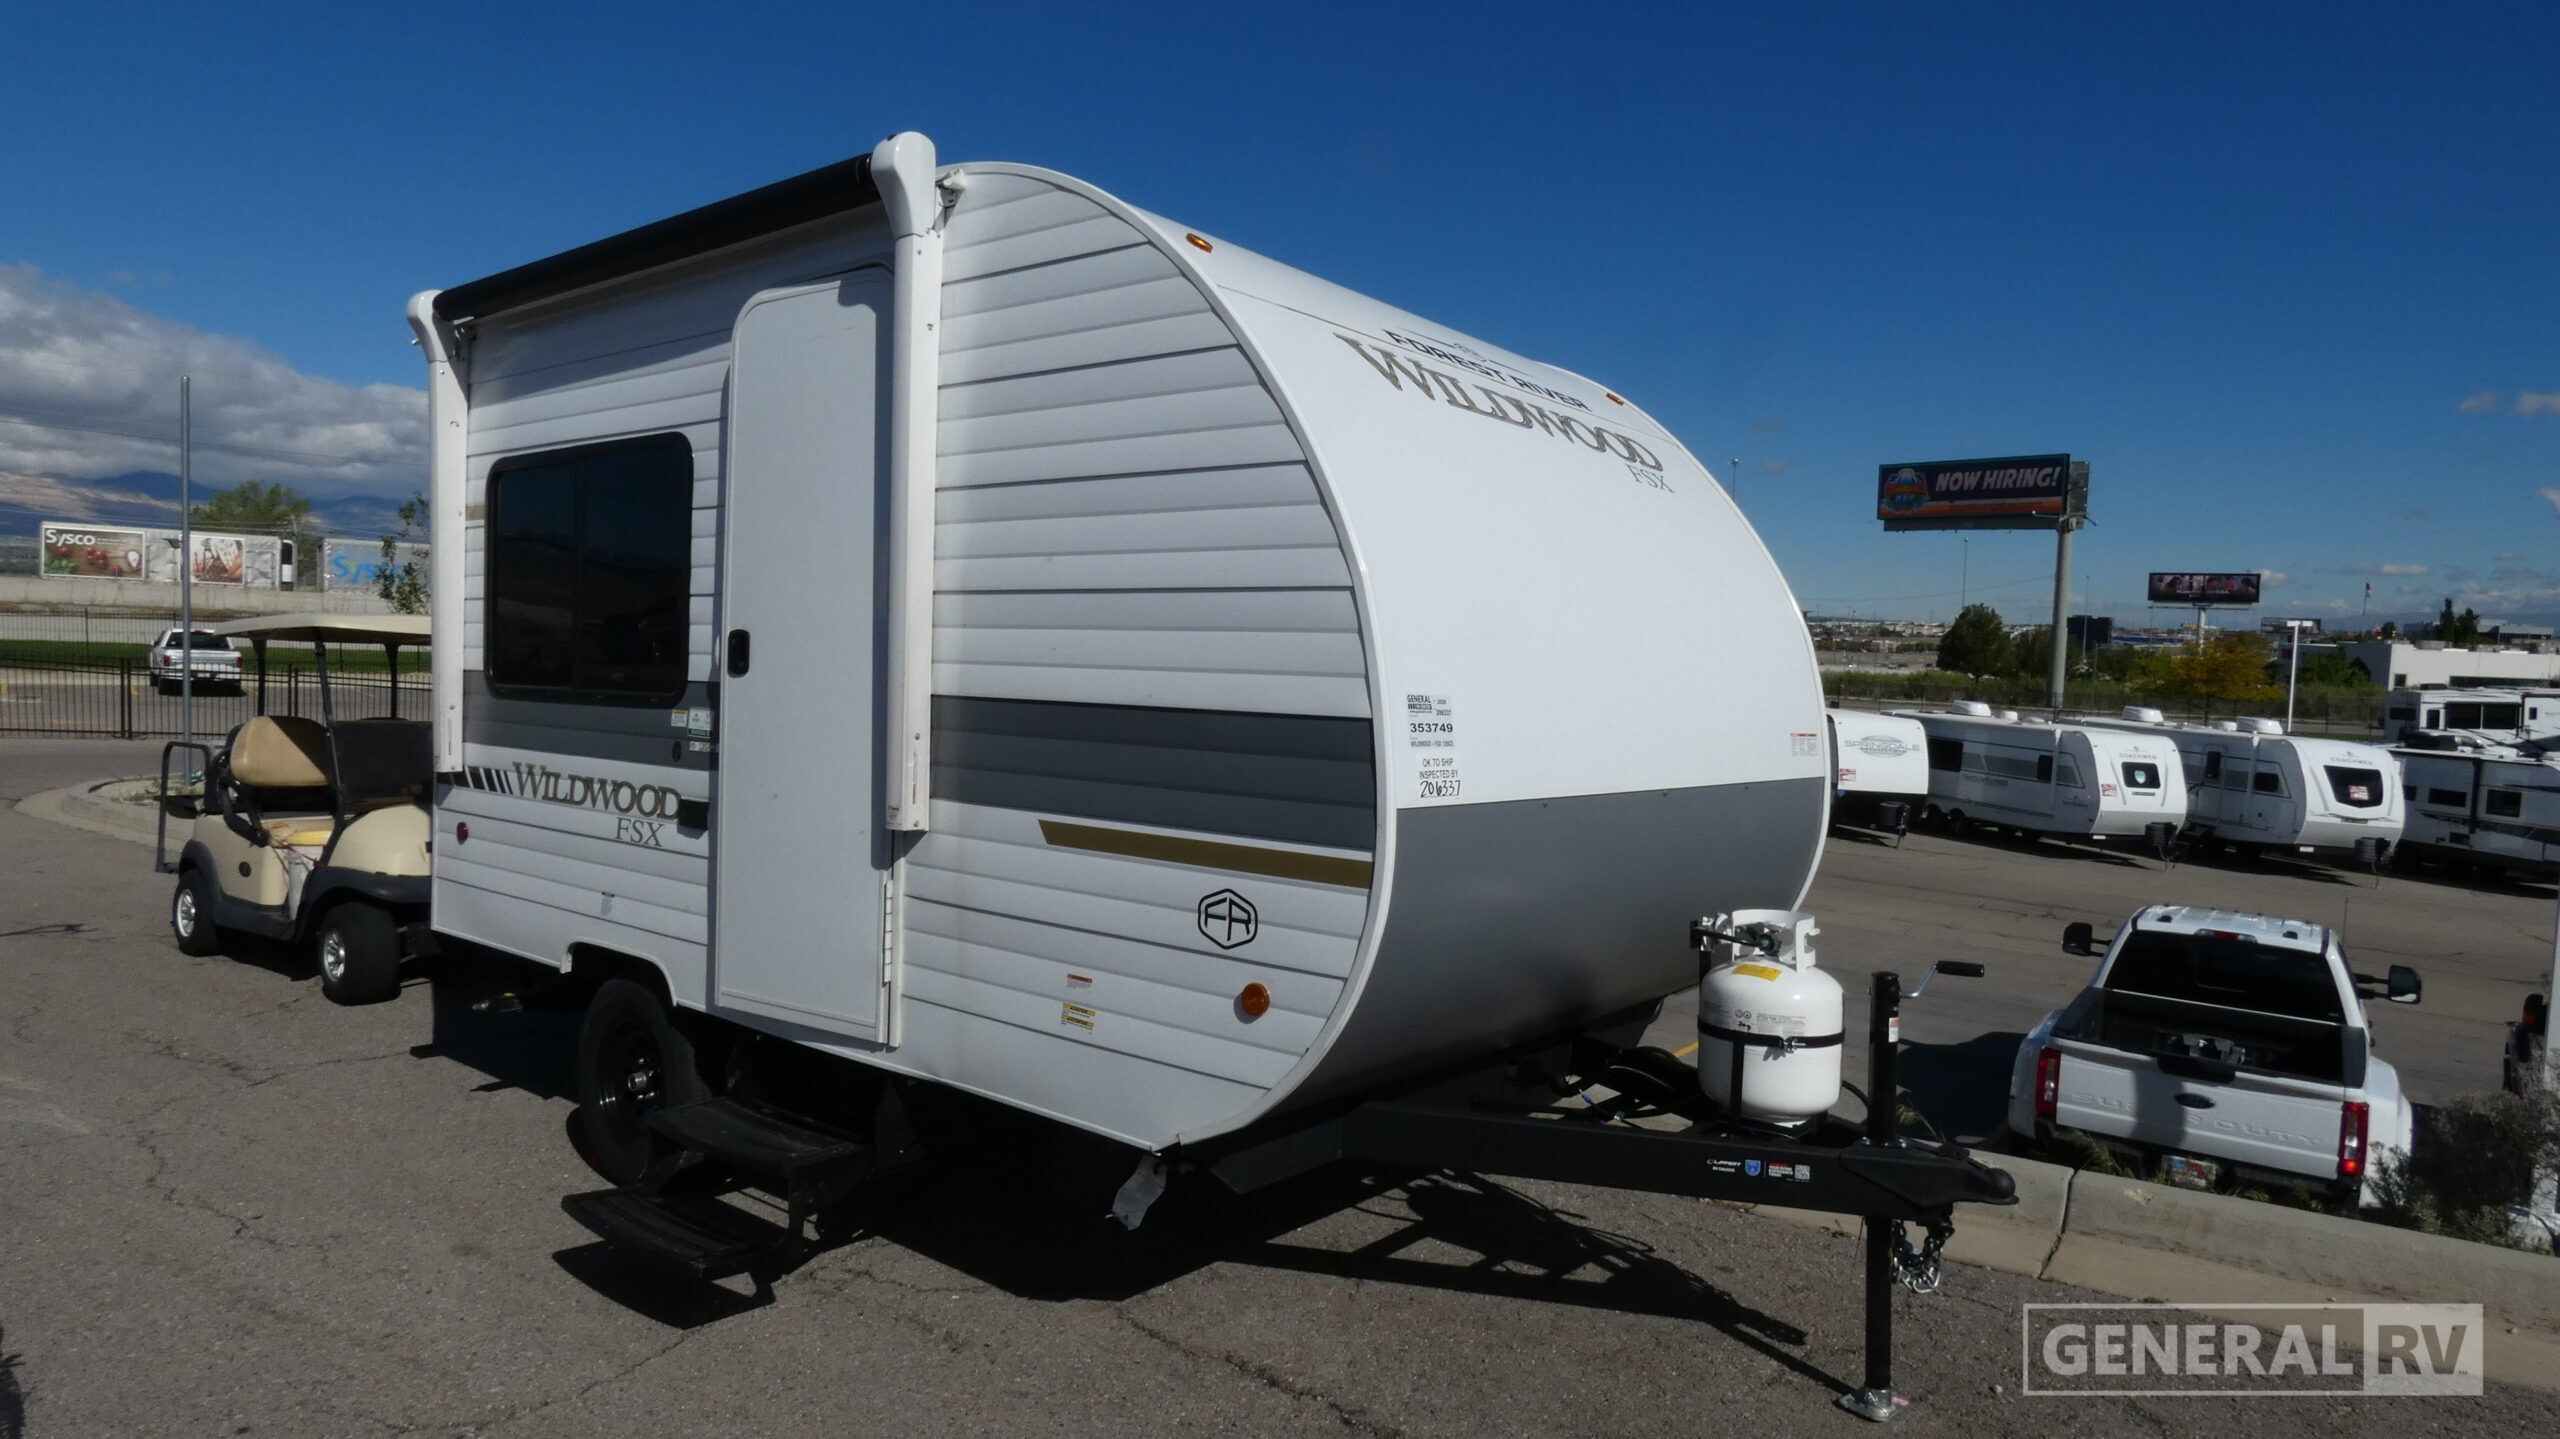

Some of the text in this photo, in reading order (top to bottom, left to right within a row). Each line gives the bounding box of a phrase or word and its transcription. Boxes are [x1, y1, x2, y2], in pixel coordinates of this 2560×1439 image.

[1381, 328, 1593, 413] FOREST RIVER
[1332, 332, 1664, 472] WILDWOOD
[1625, 463, 1676, 494] FSX
[1935, 466, 2062, 492] NOW HIRING!
[45, 529, 96, 547] Sysco
[1407, 694, 1431, 703] GENERAL
[1410, 722, 1453, 733] 353749
[1844, 739, 1920, 752] SPRINGDALE
[1422, 757, 1454, 768] OK TO SHIP
[1419, 769, 1459, 779] INSPECTED BY
[512, 761, 683, 821] WILDWOOD
[1420, 779, 1461, 798] 206337
[615, 816, 665, 848] FSX
